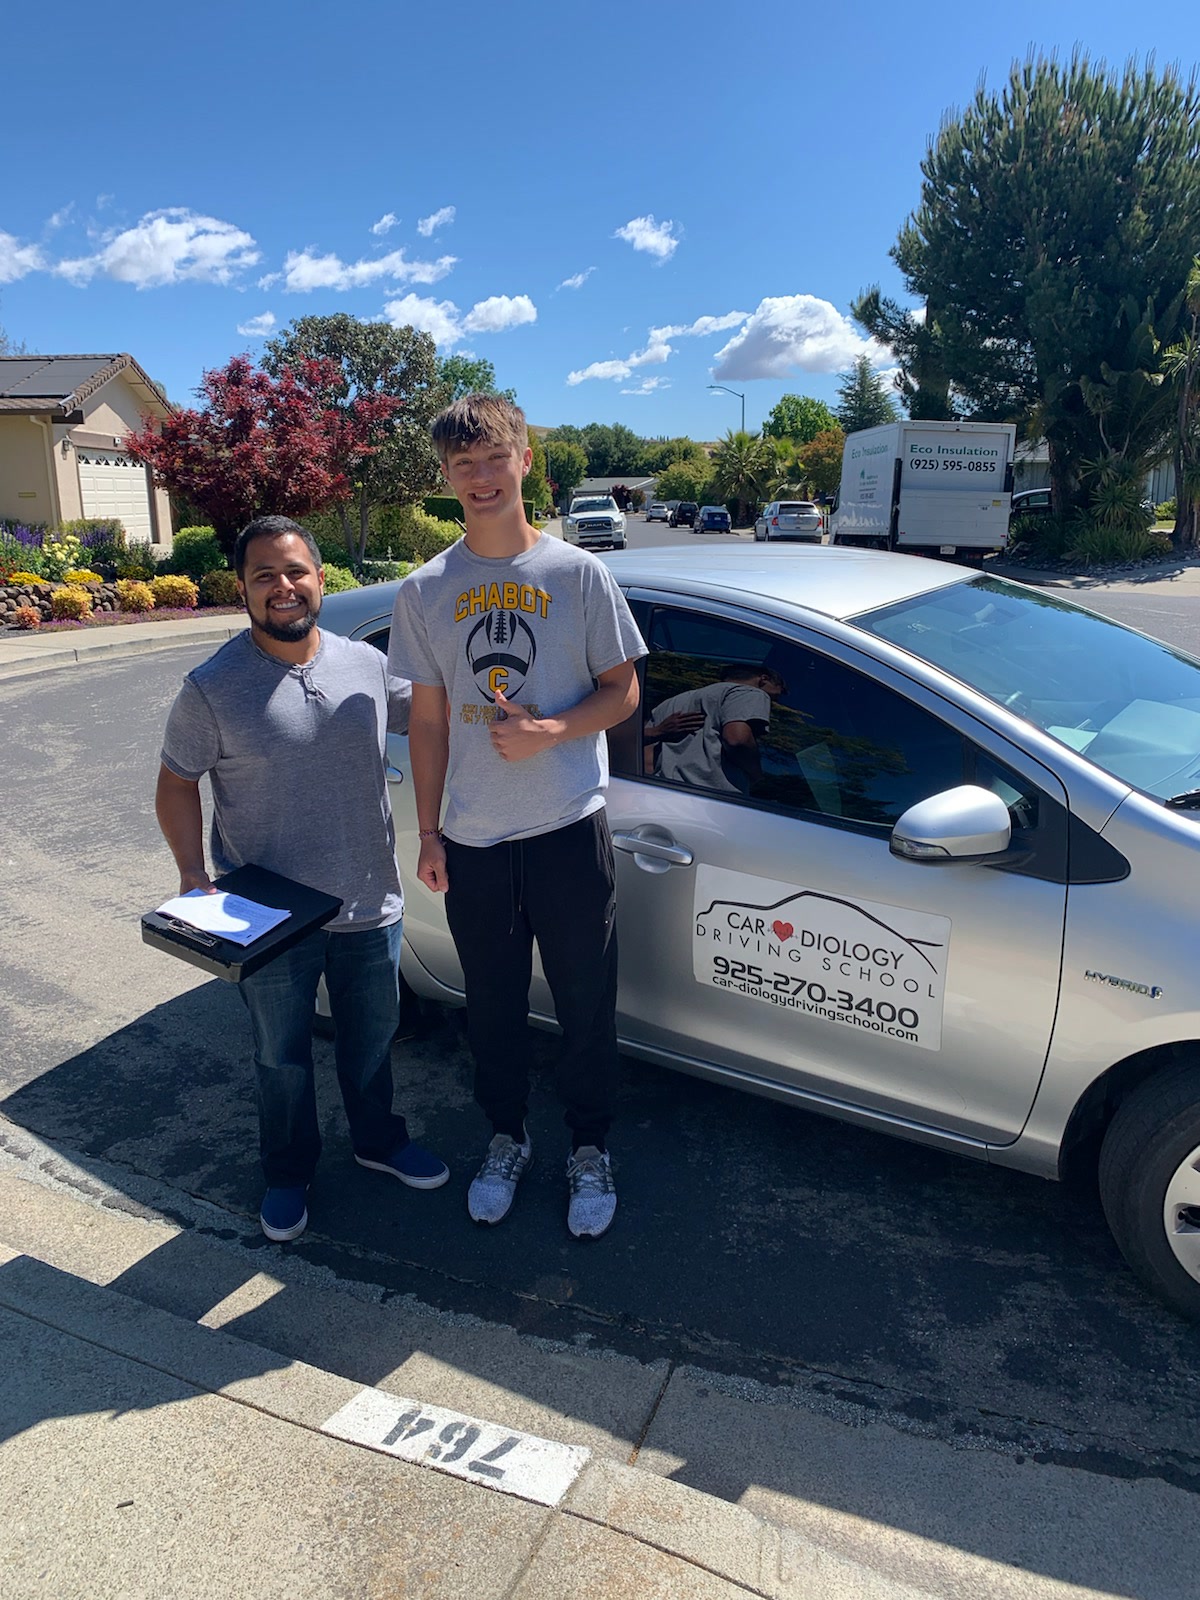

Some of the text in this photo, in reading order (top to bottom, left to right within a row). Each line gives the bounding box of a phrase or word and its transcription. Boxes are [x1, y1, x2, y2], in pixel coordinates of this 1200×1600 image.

[910, 444, 998, 457] Eco Insulation
[910, 458, 996, 473] (925) 595-0855
[454, 582, 552, 623] CHABOT
[488, 667, 509, 693] C
[697, 924, 936, 998] DRIVING SCHOOL
[727, 912, 904, 970] CAR DIOLOGY
[713, 956, 919, 1029] 925-270-3400
[1084, 969, 1150, 996] HYBRID
[712, 975, 919, 1043] car-diologydrivingschool.com
[381, 1409, 521, 1480] 764
